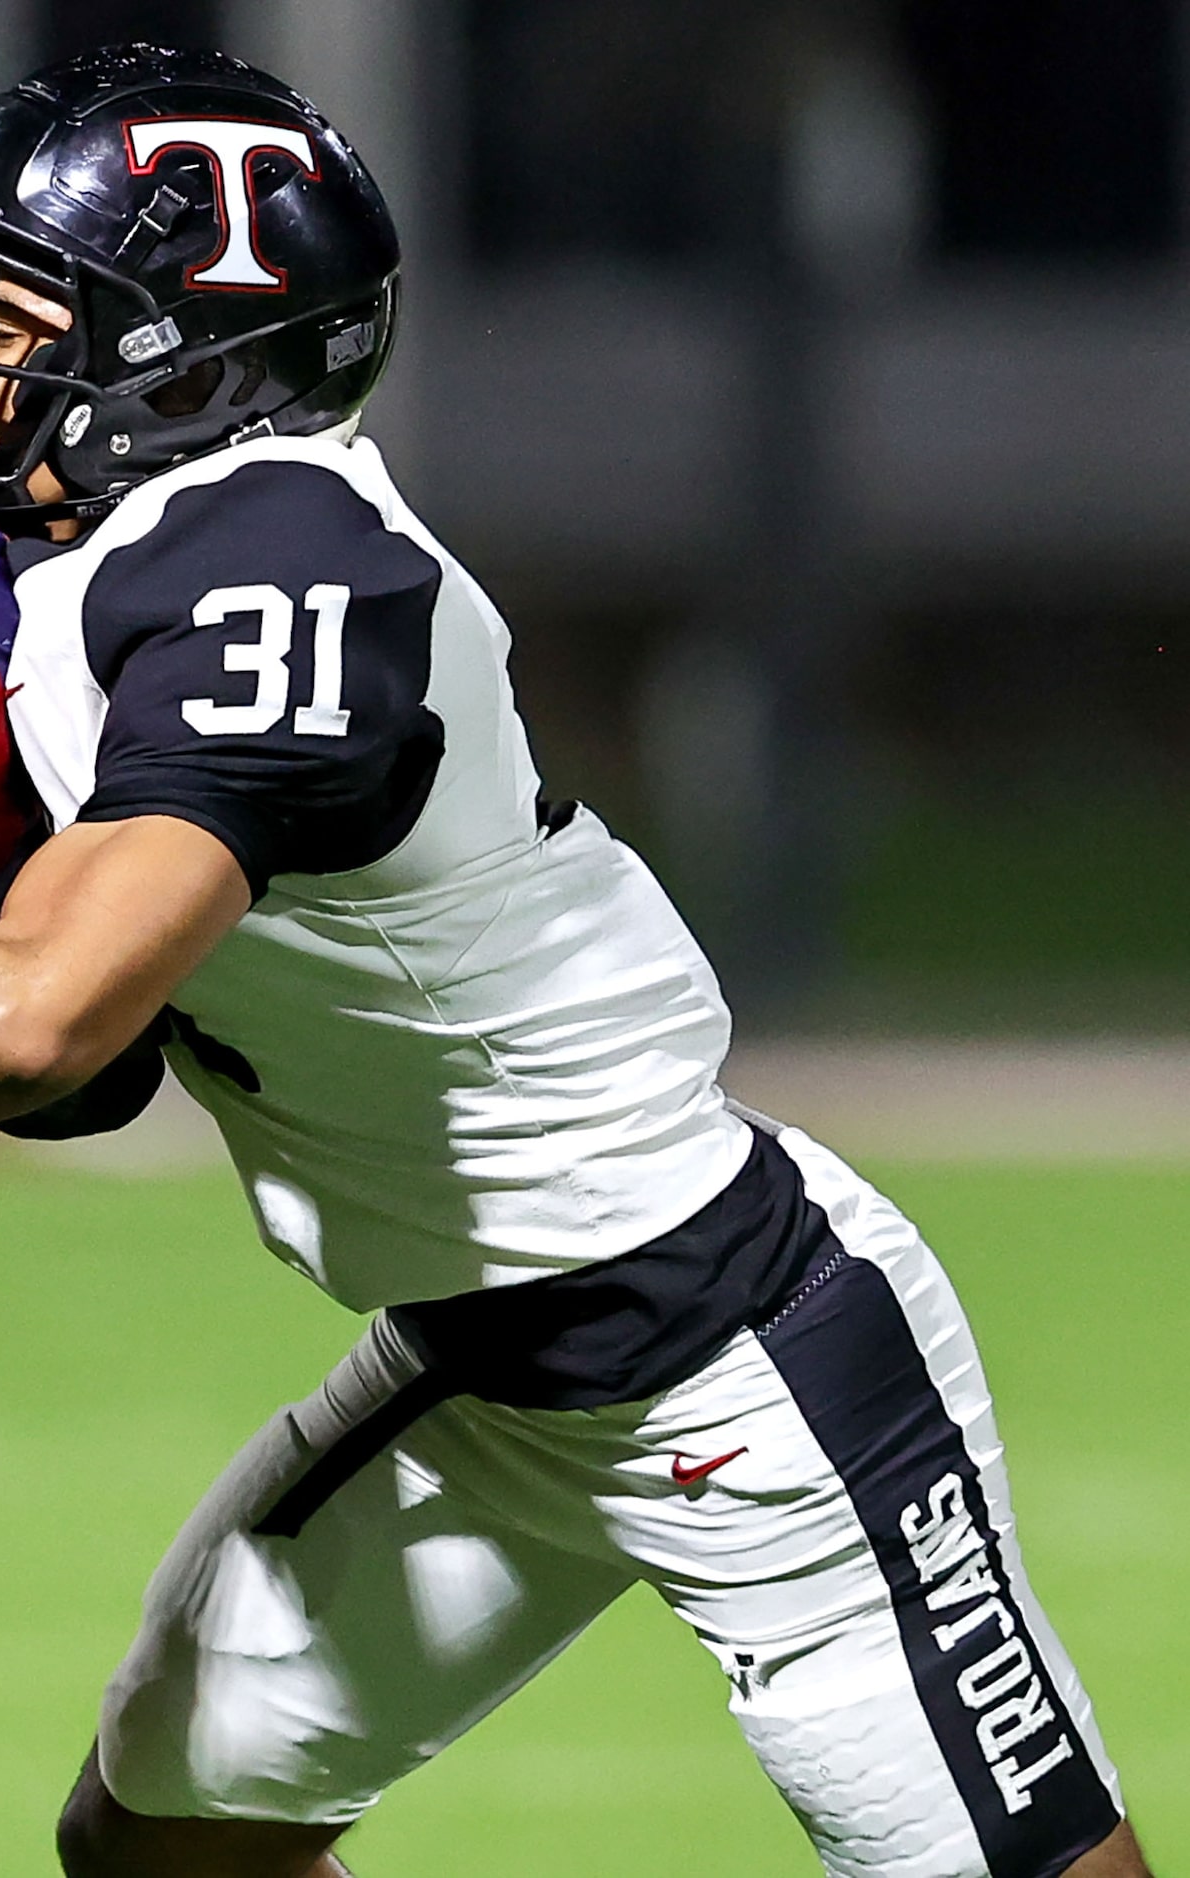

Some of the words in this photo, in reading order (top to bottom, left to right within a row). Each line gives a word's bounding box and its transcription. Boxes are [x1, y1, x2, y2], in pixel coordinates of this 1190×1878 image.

[121, 114, 321, 294] T
[181, 583, 351, 737] 31
[899, 1472, 1074, 1816] TROJANS
